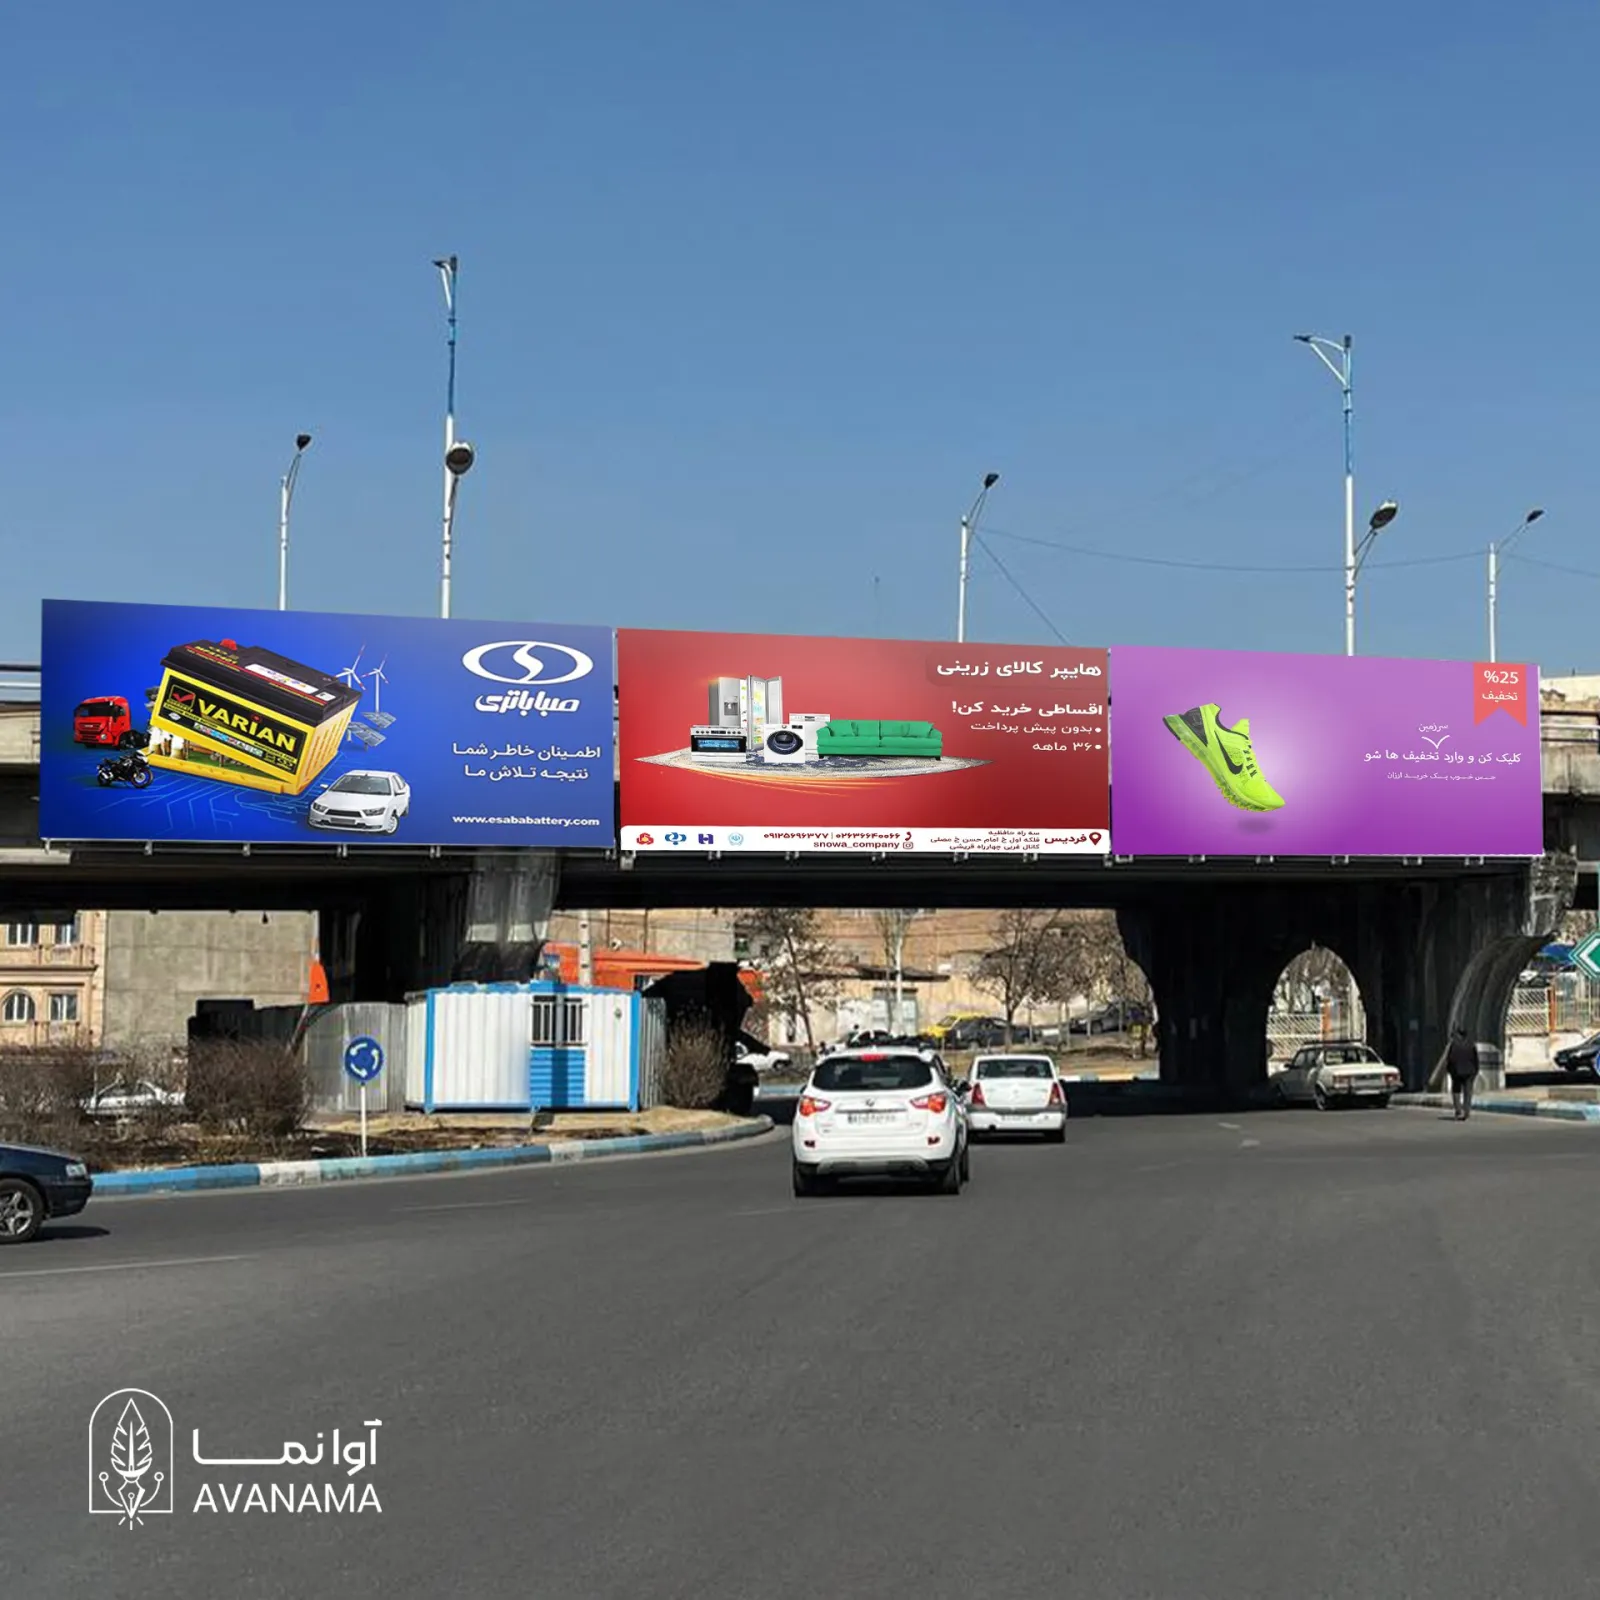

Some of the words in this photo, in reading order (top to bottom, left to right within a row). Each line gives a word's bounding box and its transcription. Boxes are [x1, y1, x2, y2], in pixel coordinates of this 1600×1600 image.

[937, 660, 989, 676] زرینی
[996, 661, 1043, 676] کالای
[1050, 663, 1102, 680] هایپر
[1482, 690, 1518, 703] تخفیف
[951, 701, 984, 716] کن!
[991, 702, 1032, 716] خرید
[1038, 703, 1103, 717] اقساطی
[970, 721, 1019, 734] پرداخت
[1023, 722, 1057, 735] پیش
[1061, 725, 1093, 735] بدون
[1418, 722, 1449, 733] سرزمین
[452, 742, 489, 756] شما
[490, 743, 535, 760] خاطر
[1032, 741, 1067, 752] ماهه
[1072, 741, 1093, 752] ۳۶
[537, 746, 601, 761] اطمینان
[1363, 750, 1382, 762] شو
[1385, 749, 1399, 760] ها
[1402, 750, 1440, 763] تخفیف
[1443, 751, 1464, 764] وارد
[1467, 755, 1475, 764] و
[1477, 752, 1493, 764] کن
[1495, 752, 1522, 765] کلیک
[464, 764, 486, 777] ما
[489, 765, 537, 781] تلاش
[540, 767, 589, 782] نتیجه
[452, 815, 600, 828] www.esababattery.com
[813, 840, 900, 850] snowa_company
[1044, 833, 1088, 845] فردیس
